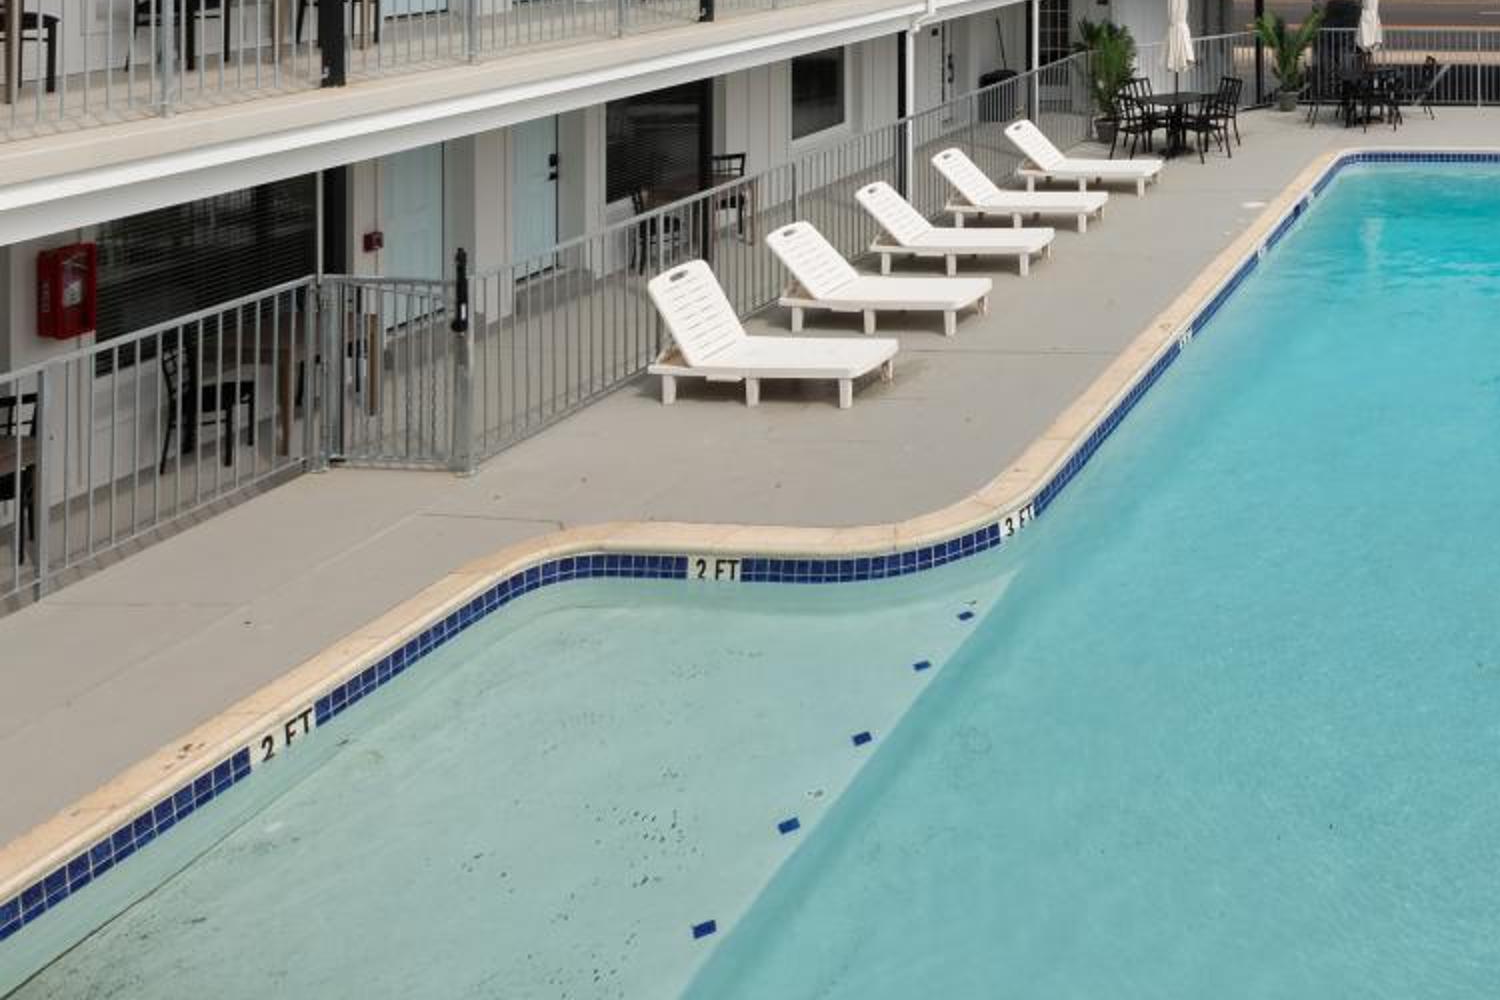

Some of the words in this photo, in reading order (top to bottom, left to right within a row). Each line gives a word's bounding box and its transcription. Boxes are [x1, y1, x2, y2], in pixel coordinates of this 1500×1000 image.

[1005, 517, 1015, 537] 3
[1019, 502, 1033, 529] FT
[696, 558, 706, 579] 2
[715, 559, 739, 581] FT
[261, 734, 275, 763] 2
[285, 707, 313, 746] FT
